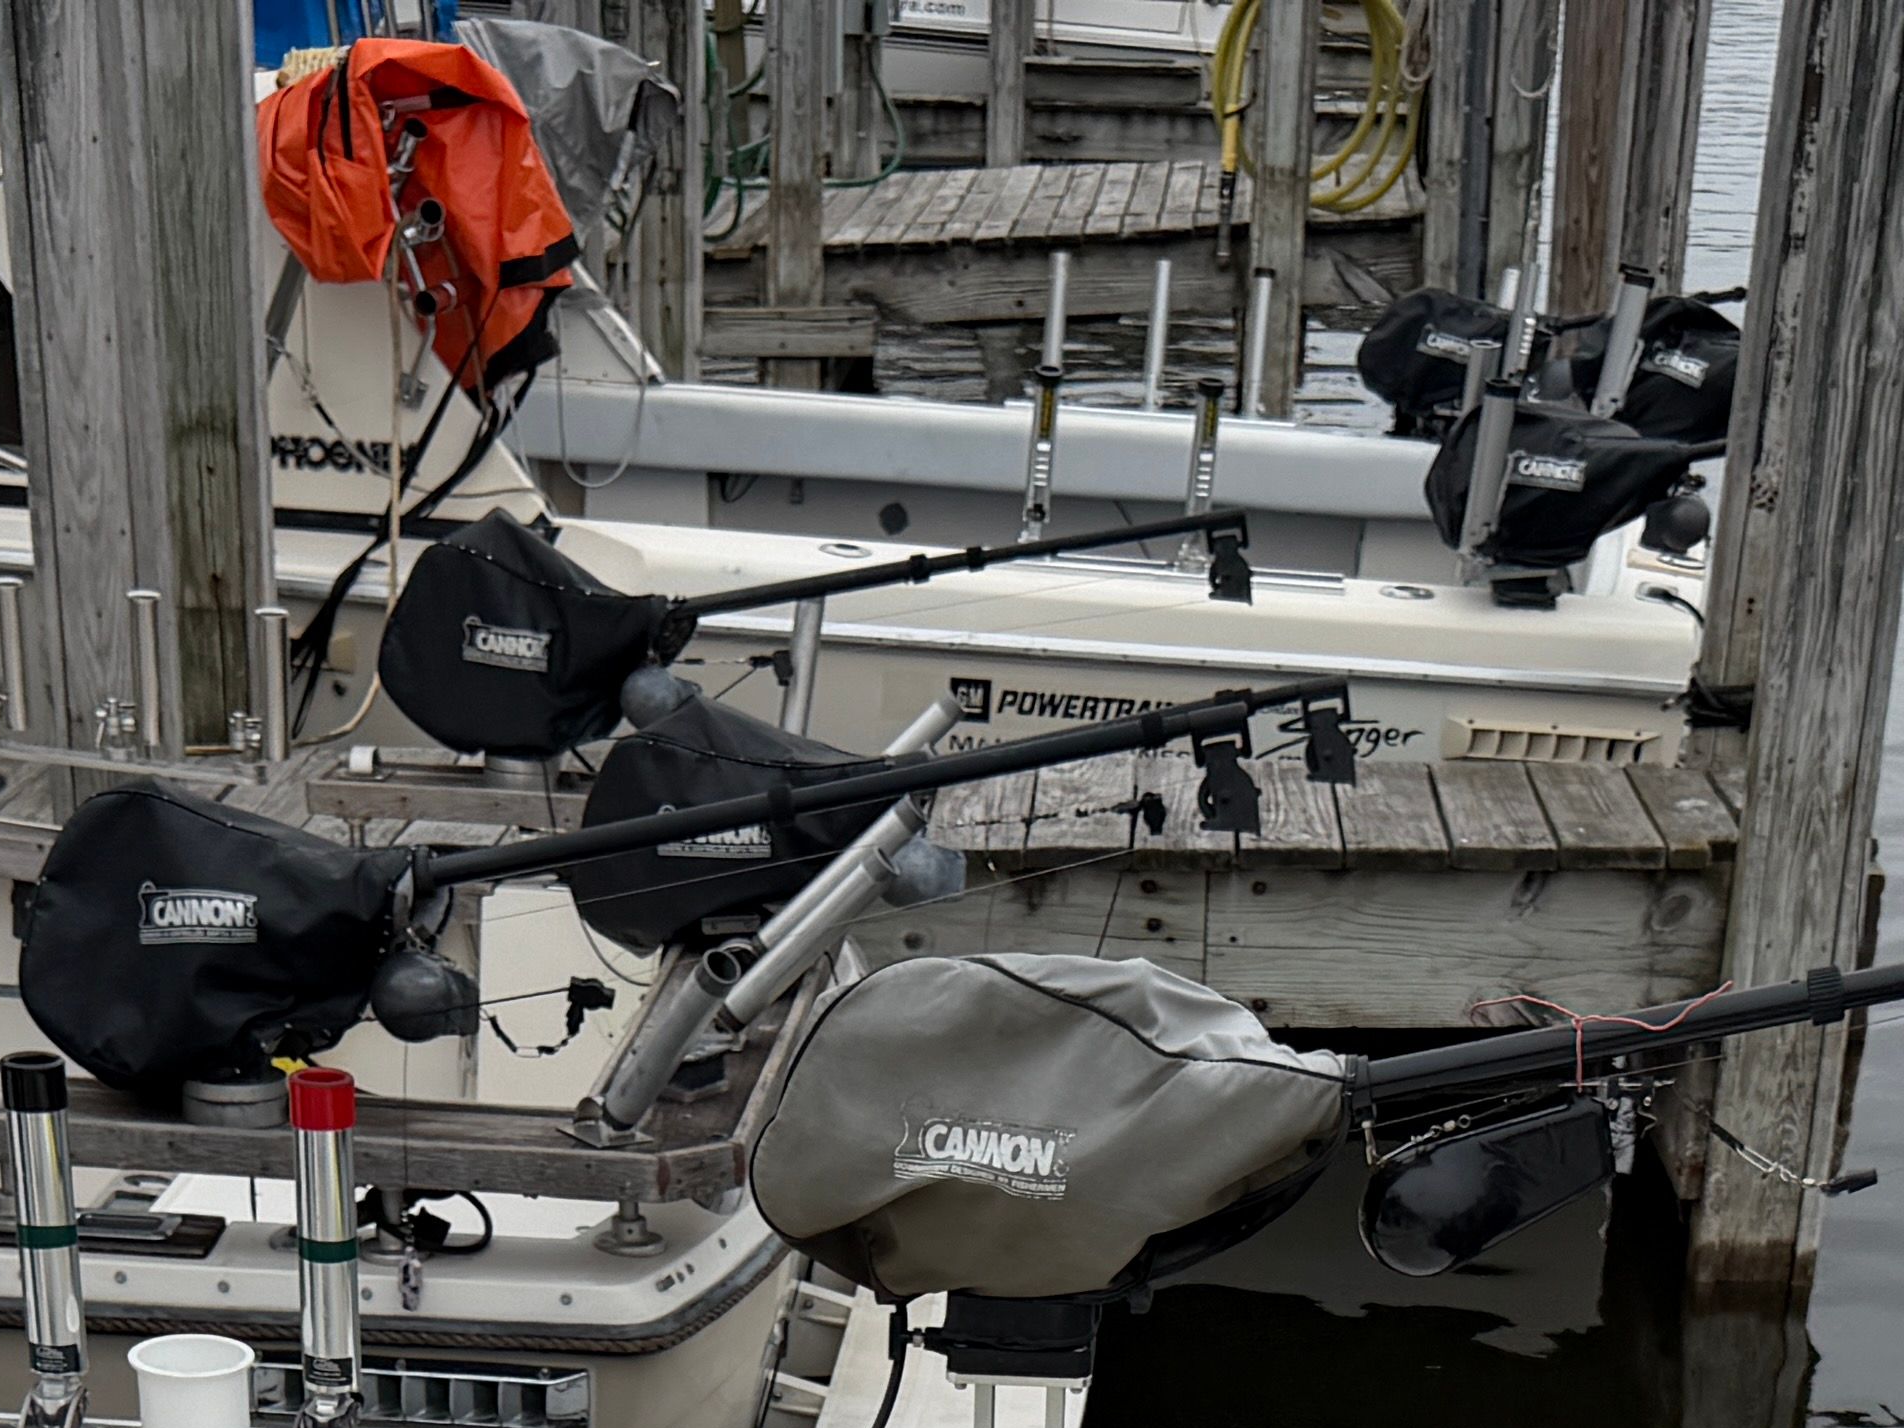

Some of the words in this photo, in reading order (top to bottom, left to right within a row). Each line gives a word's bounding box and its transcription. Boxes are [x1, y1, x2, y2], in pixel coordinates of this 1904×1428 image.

[957, 686, 985, 707] GM
[997, 690, 1180, 721] POWERTRA
[154, 899, 244, 928] CANNON
[924, 1123, 1056, 1177] CANNON
